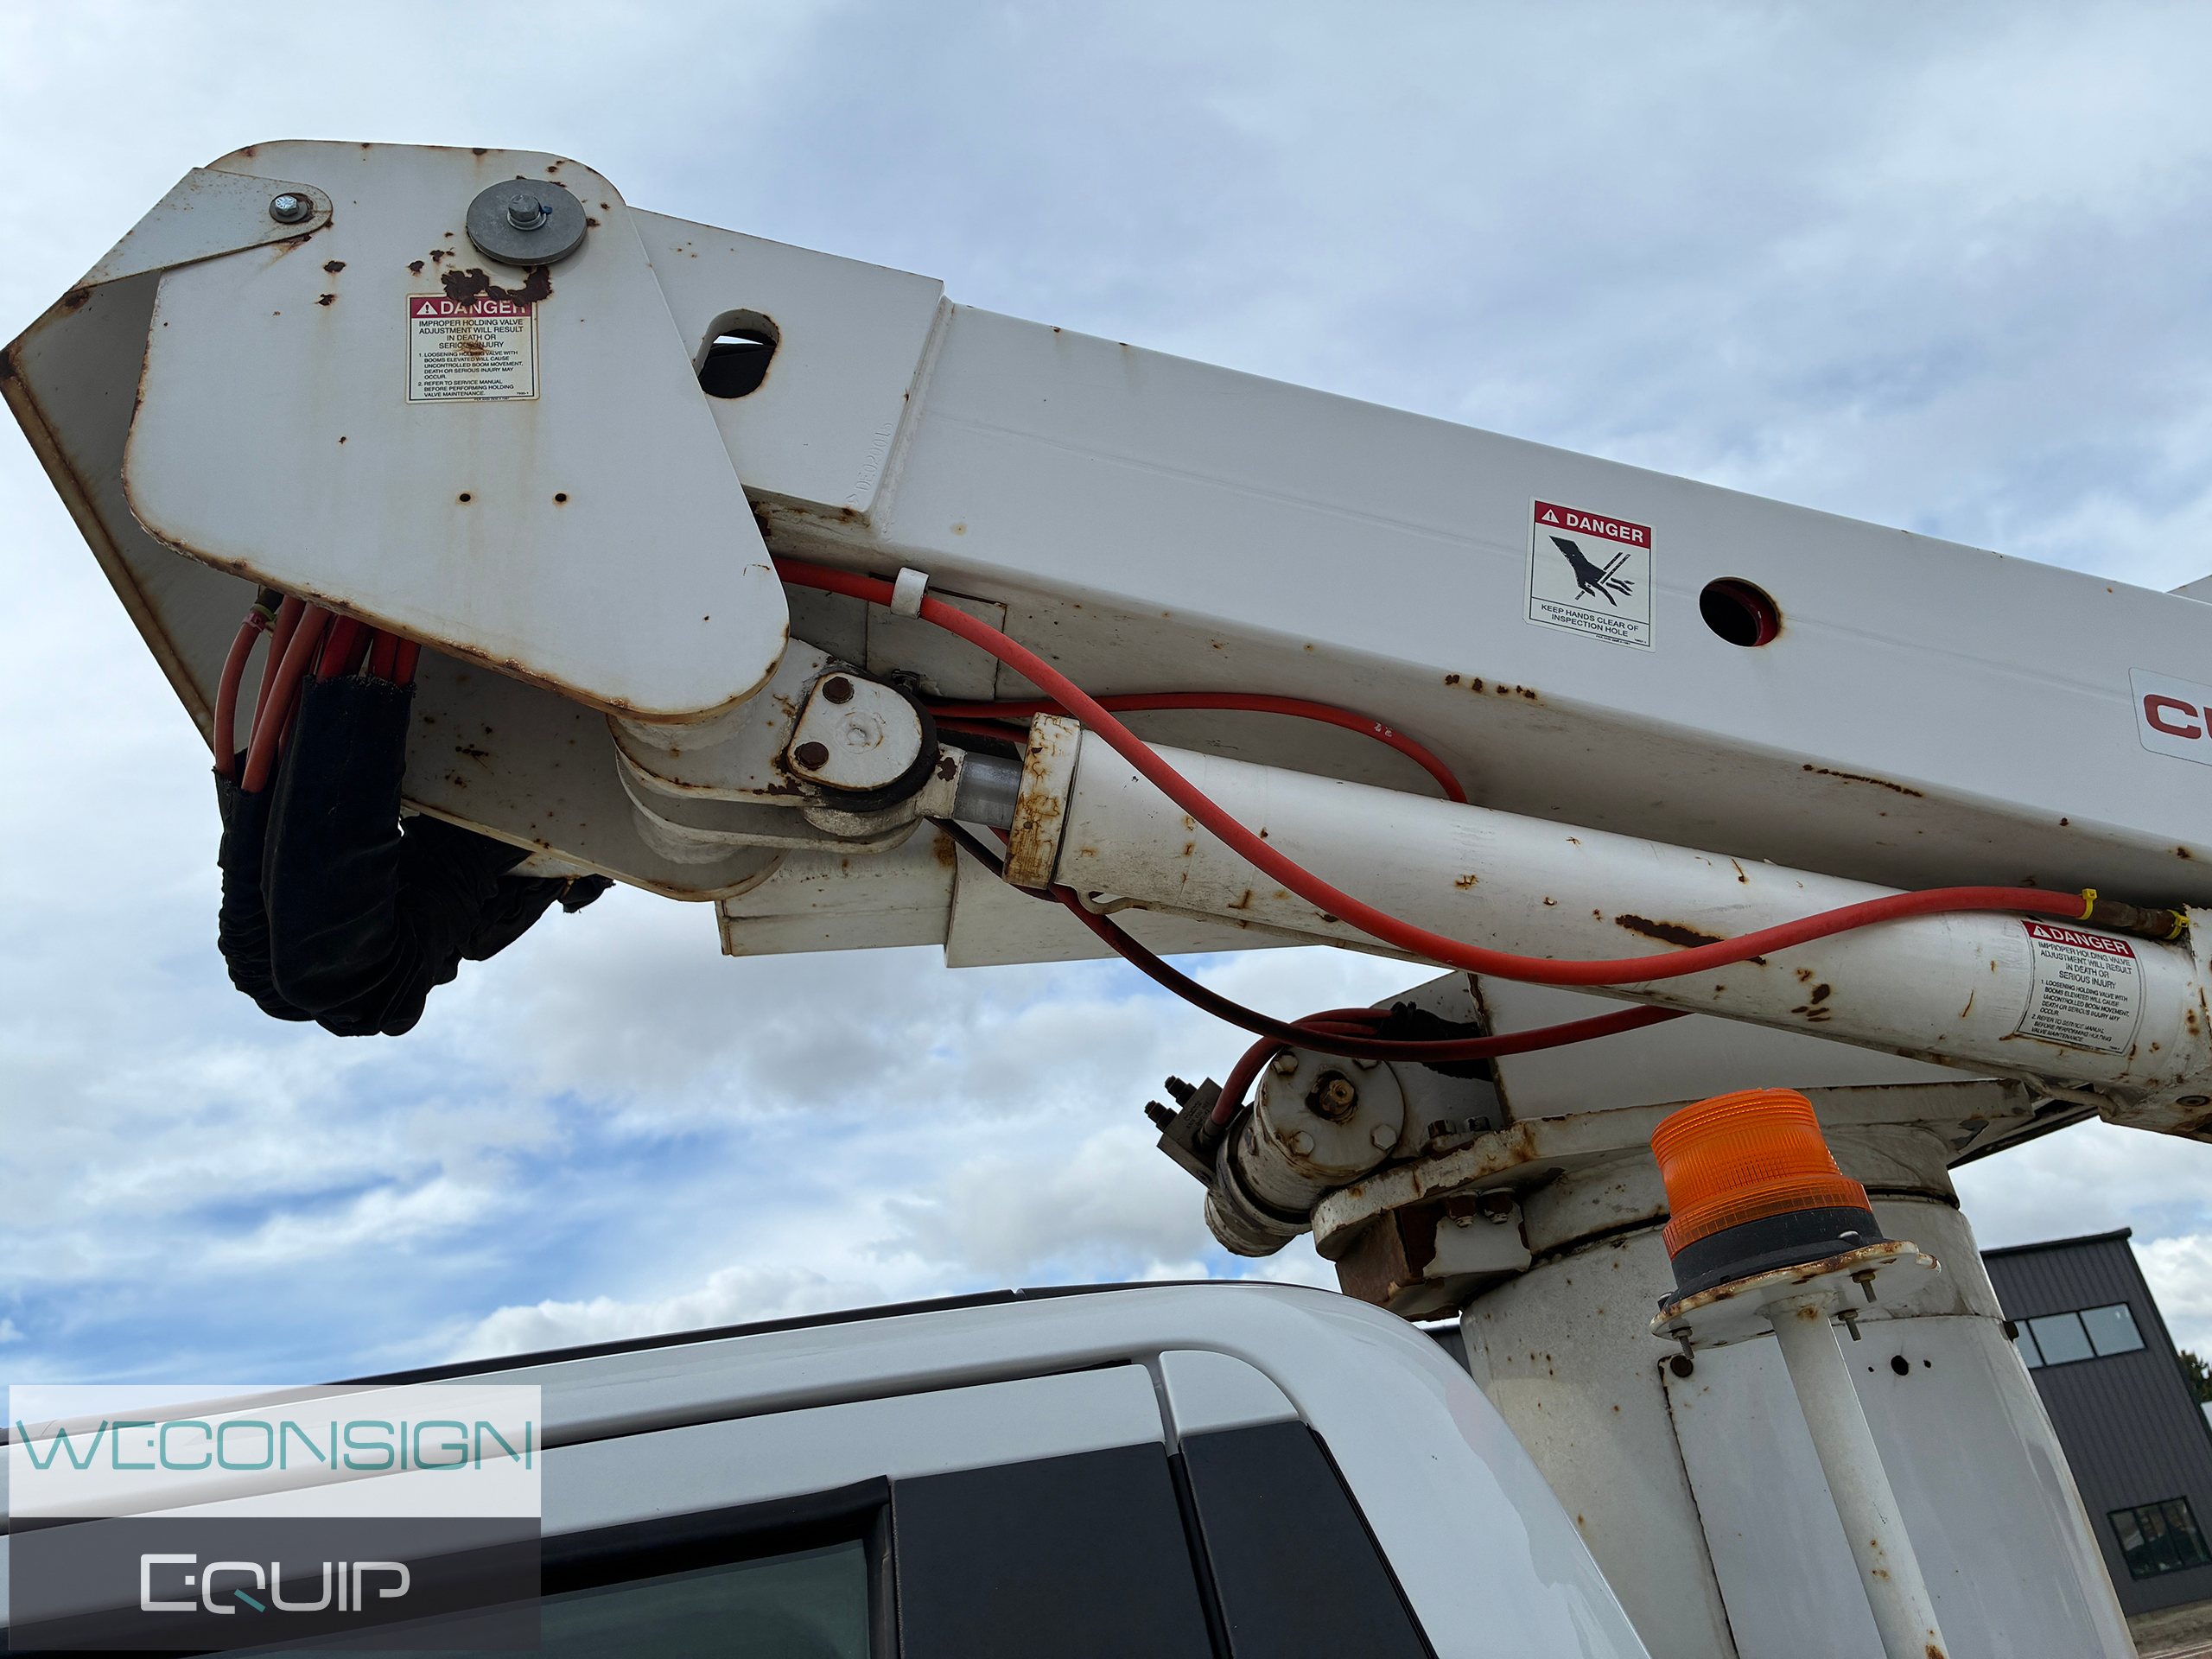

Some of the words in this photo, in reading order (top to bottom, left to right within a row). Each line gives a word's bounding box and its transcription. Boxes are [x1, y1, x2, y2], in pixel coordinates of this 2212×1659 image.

[441, 300, 526, 315] DANGER
[1567, 512, 1643, 543] DANGER
[1541, 604, 1564, 614] KEEP
[1566, 609, 1595, 621] HANDS
[1597, 616, 1625, 629] CLEAR
[1626, 623, 1639, 632] OF
[1551, 613, 1604, 631] INSPECTION
[1605, 626, 1629, 637] HOLE
[2143, 694, 2212, 741] C
[2037, 941, 2076, 957] IMPROPER
[2077, 950, 2109, 961] HOLDING
[2108, 955, 2131, 966] VALVE
[2049, 928, 2130, 955] DANGER
[2040, 950, 2087, 963] ADJUSTMENT
[2088, 959, 2104, 969] WILL
[2106, 963, 2132, 975] RESULT
[2074, 964, 2097, 976] DEATH
[2098, 969, 2110, 979] OR
[2045, 980, 2075, 991] LOOSENING
[2075, 986, 2099, 995] HOLDING
[2099, 990, 2114, 1000] VALVE
[2114, 994, 2128, 1002] WITH
[2058, 970, 2090, 984] SERIOUS
[2091, 977, 2116, 989] INJURY
[2044, 987, 2064, 995] BOOMS
[2064, 990, 2089, 1001] ELEVATED
[2089, 995, 2101, 1004] WILL
[2101, 998, 2120, 1007] CAUSE
[2037, 1014, 2055, 1024] REFER
